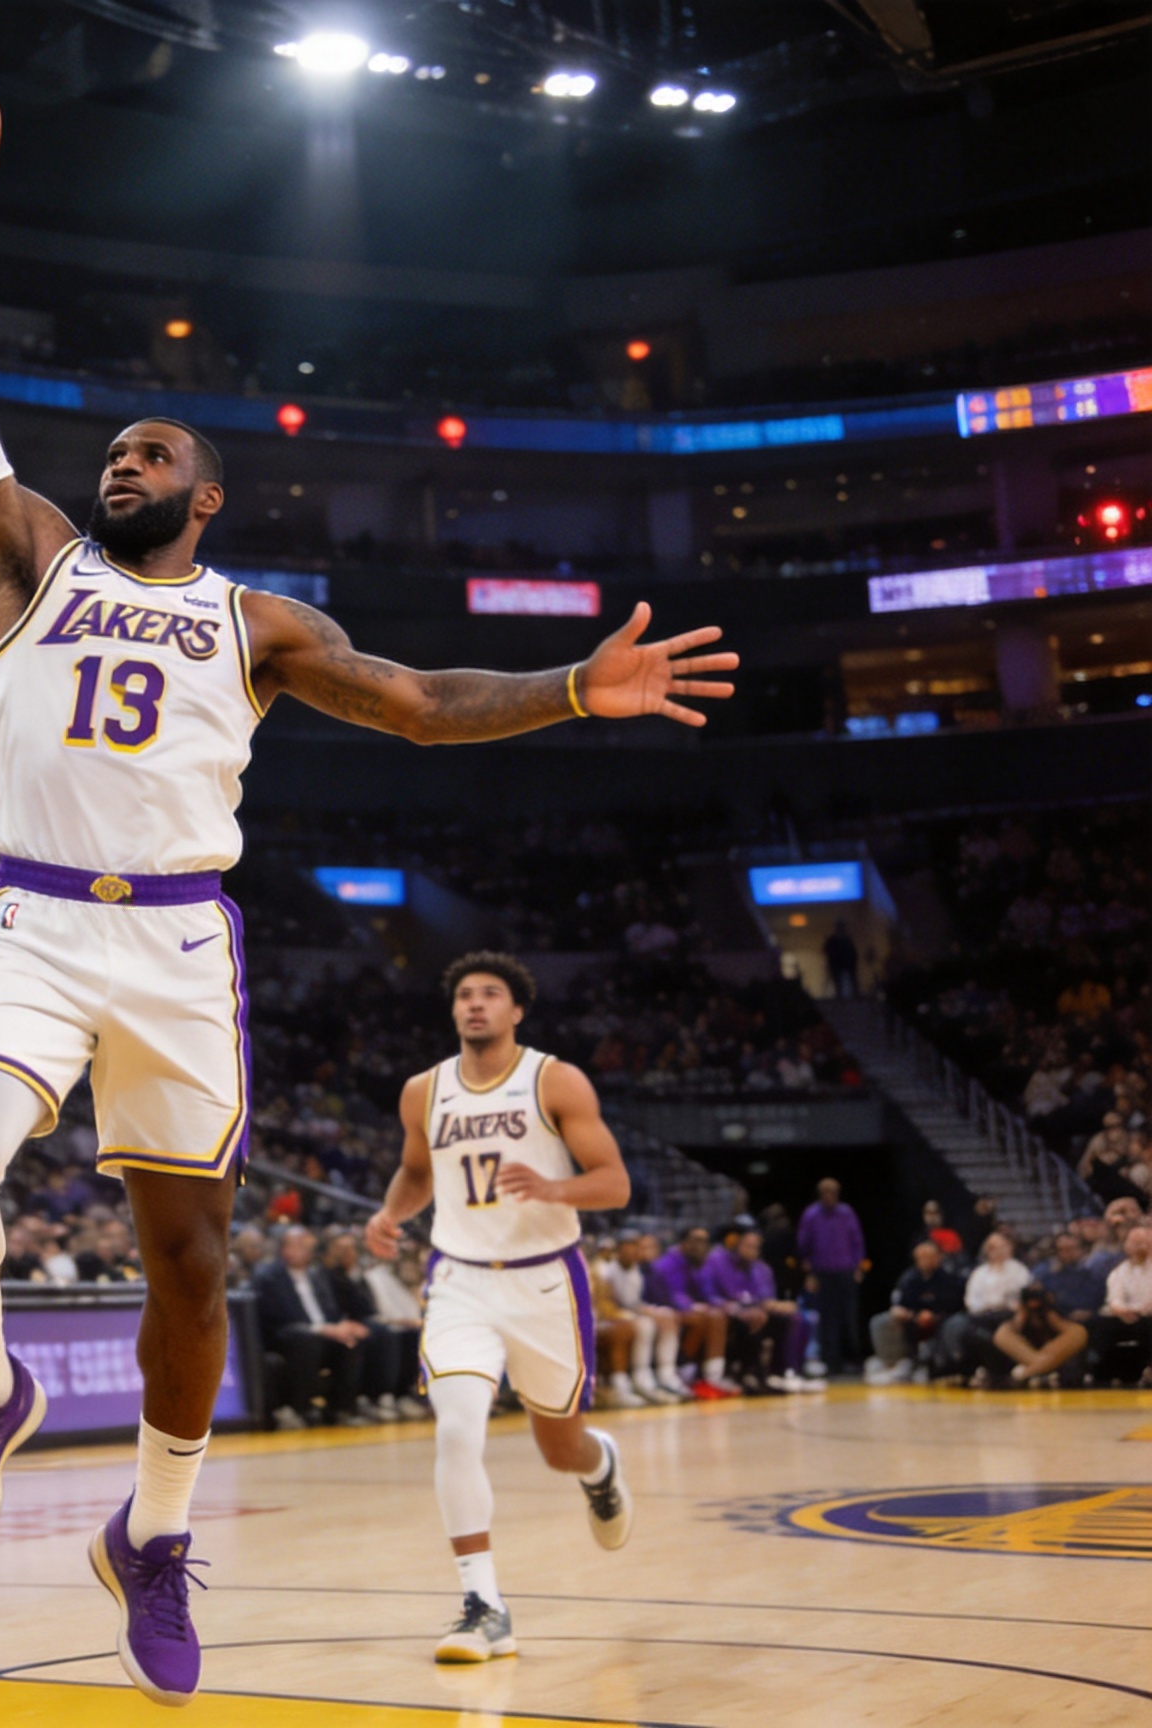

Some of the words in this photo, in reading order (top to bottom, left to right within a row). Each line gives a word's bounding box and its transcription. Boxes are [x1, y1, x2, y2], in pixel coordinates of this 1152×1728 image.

[35, 588, 222, 662] LAKERS
[63, 655, 165, 754] 13
[460, 1151, 502, 1208] 17
